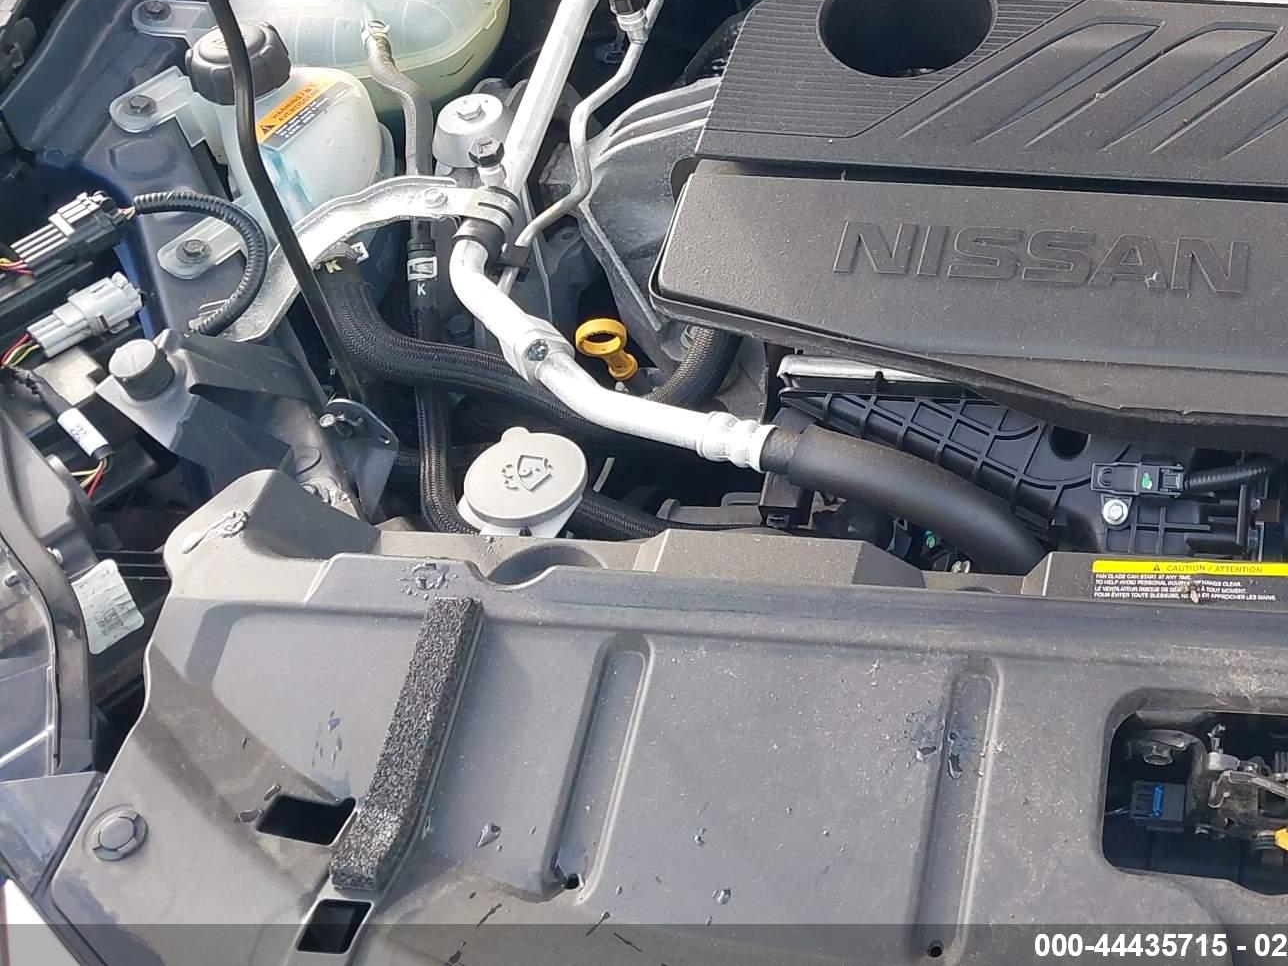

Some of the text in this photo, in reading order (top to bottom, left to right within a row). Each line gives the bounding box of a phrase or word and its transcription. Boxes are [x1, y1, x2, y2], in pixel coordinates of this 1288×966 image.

[832, 220, 1250, 294] NISSAN
[417, 282, 427, 296] K
[1166, 564, 1205, 572] CAUTION
[1214, 565, 1263, 573] ATTENTION
